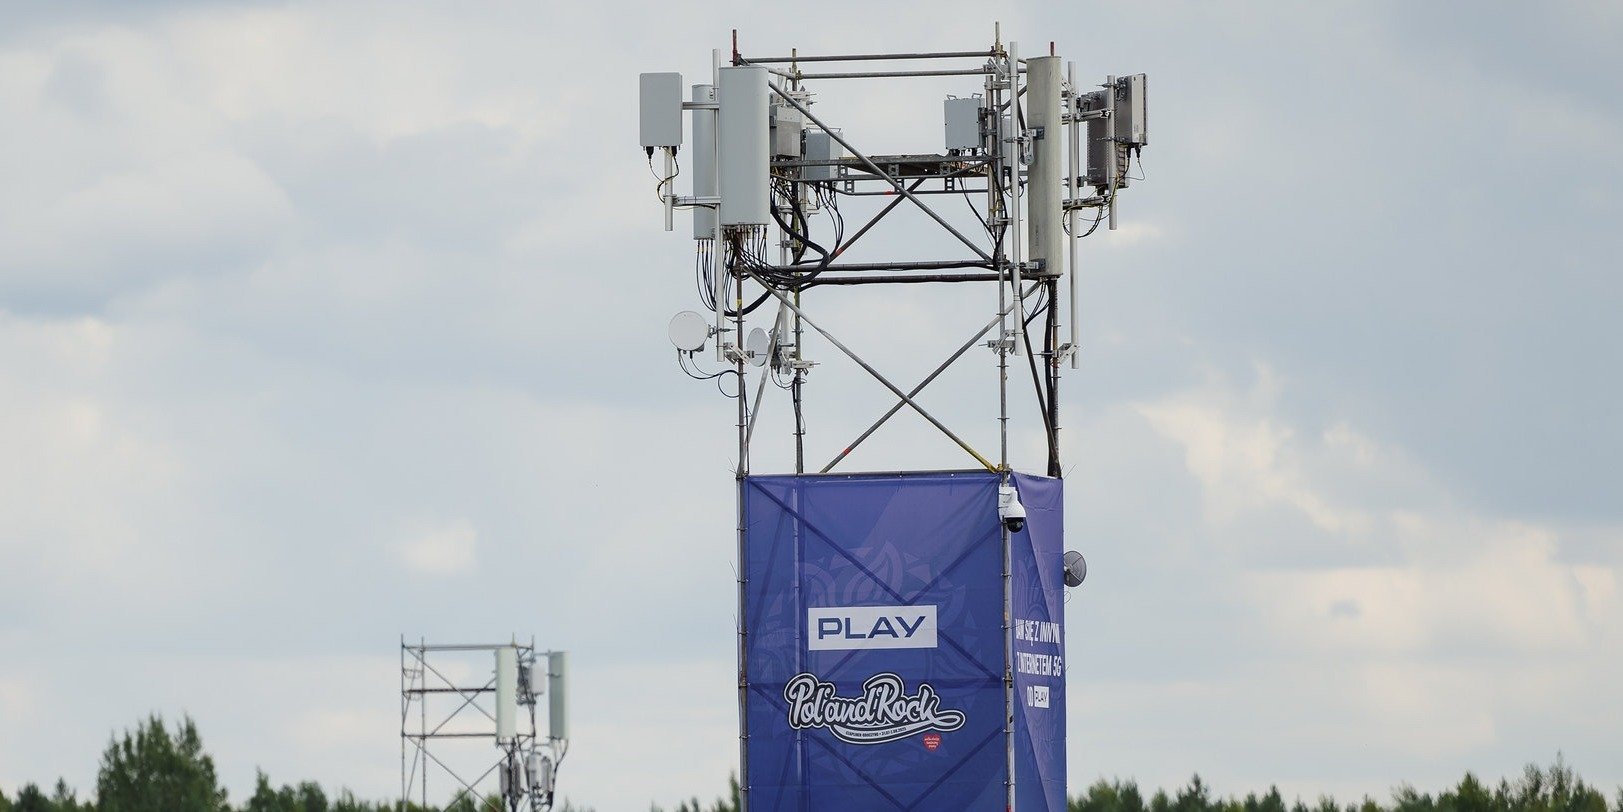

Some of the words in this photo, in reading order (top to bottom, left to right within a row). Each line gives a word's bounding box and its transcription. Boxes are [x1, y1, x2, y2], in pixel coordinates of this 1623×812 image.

[818, 615, 927, 640] PLAY
[1034, 621, 1040, 641] Z
[1053, 655, 1062, 677] 5G
